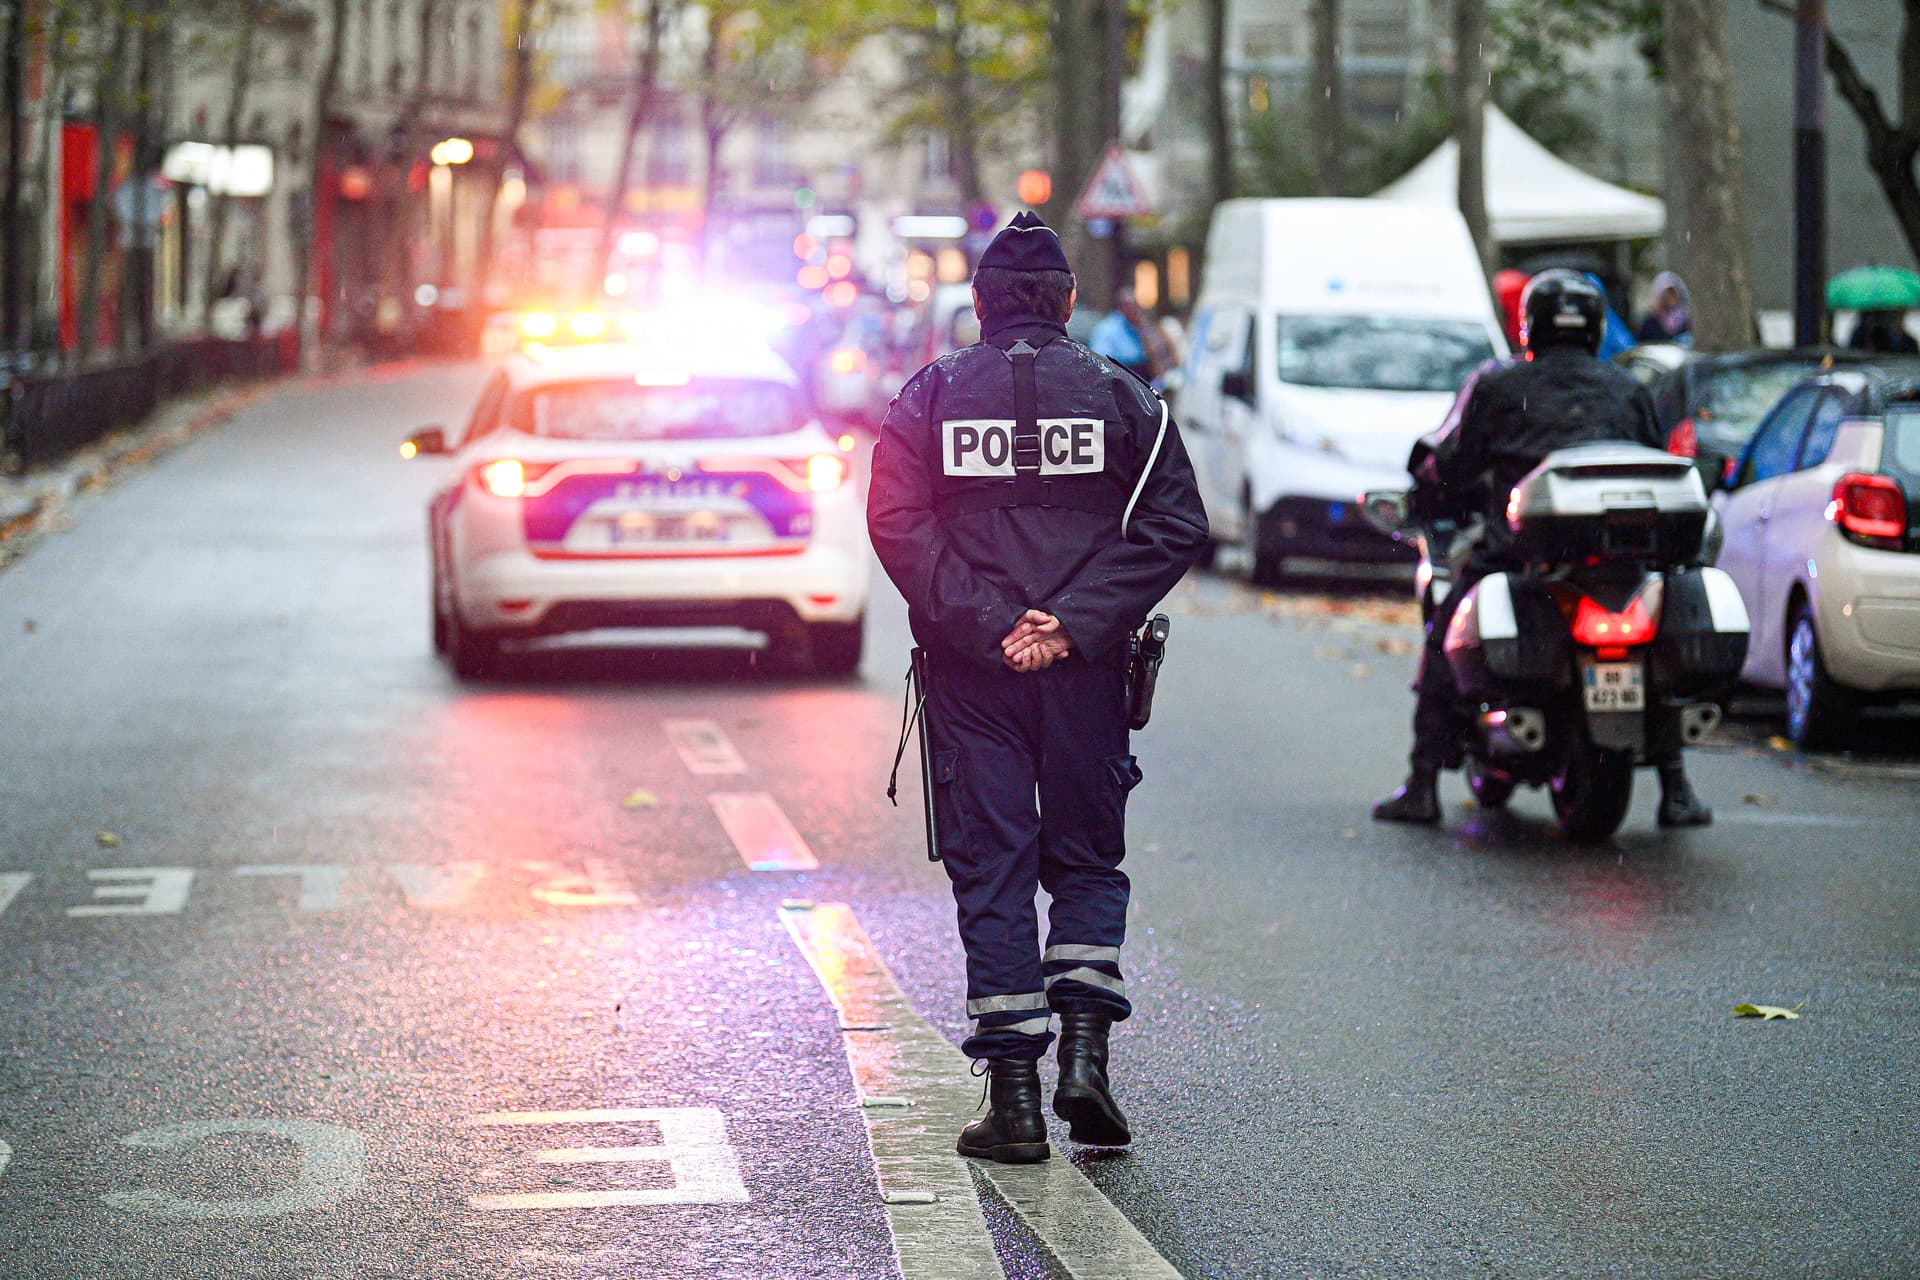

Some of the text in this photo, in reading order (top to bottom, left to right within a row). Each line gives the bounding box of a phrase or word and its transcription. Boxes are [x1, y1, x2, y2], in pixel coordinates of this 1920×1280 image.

[953, 423, 1094, 467] POCE
[0, 859, 640, 916] RALE
[0, 1106, 749, 1217] EC
